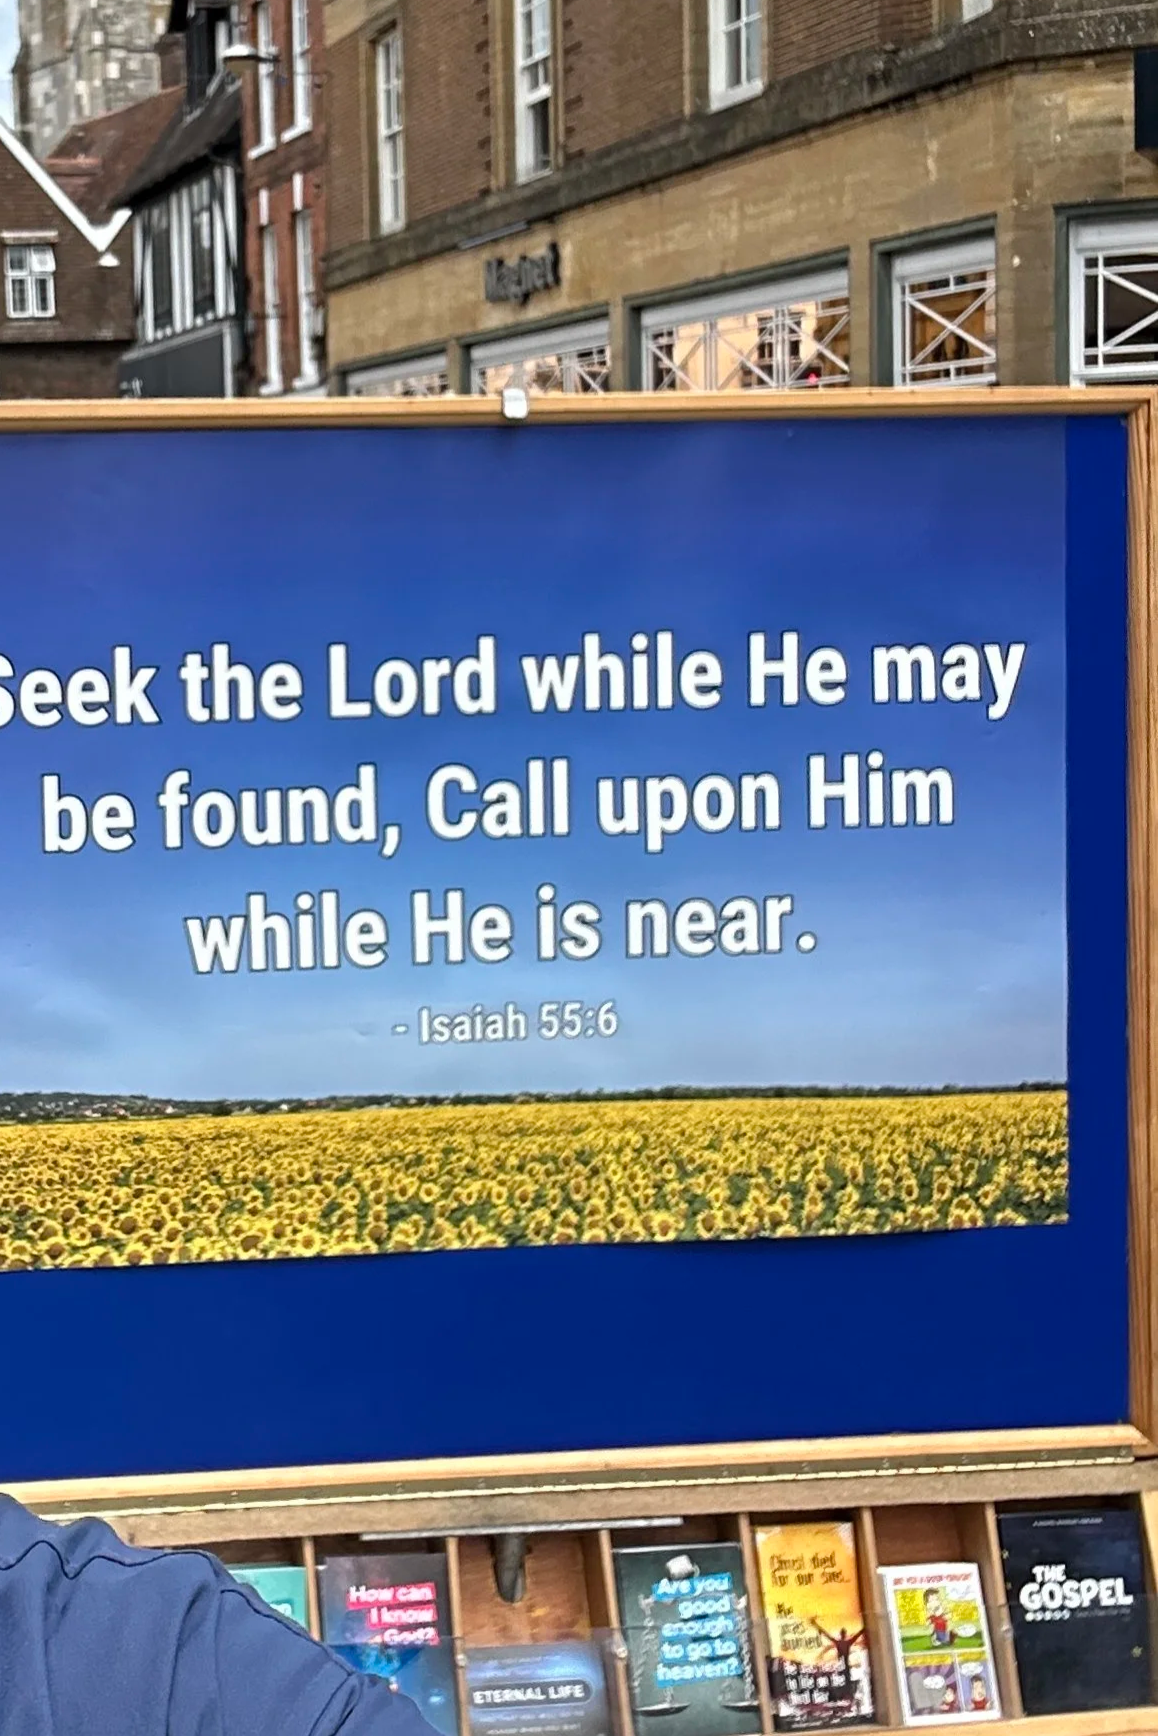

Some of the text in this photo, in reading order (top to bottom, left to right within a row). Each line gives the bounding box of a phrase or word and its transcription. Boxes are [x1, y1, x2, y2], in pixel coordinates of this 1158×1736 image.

[179, 642, 303, 723] the
[328, 634, 496, 718] Lord
[520, 629, 723, 713] while
[748, 630, 847, 707] He
[872, 641, 1028, 721] may
[41, 749, 955, 858] be found, Call upon Him
[182, 882, 819, 975] while He is near.
[418, 1003, 527, 1045] Isaiah
[537, 1001, 618, 1039] 55:6
[1032, 1564, 1067, 1583] THE
[349, 1585, 433, 1603] How can
[657, 1577, 729, 1597] Are you
[1019, 1577, 1134, 1611] GOSPEL
[369, 1606, 434, 1624] I know
[679, 1594, 731, 1620] good
[662, 1615, 733, 1638] enough
[661, 1638, 736, 1661] to go to
[657, 1656, 738, 1681] heaven?
[473, 1684, 585, 1705] ETERNAL LIFE
